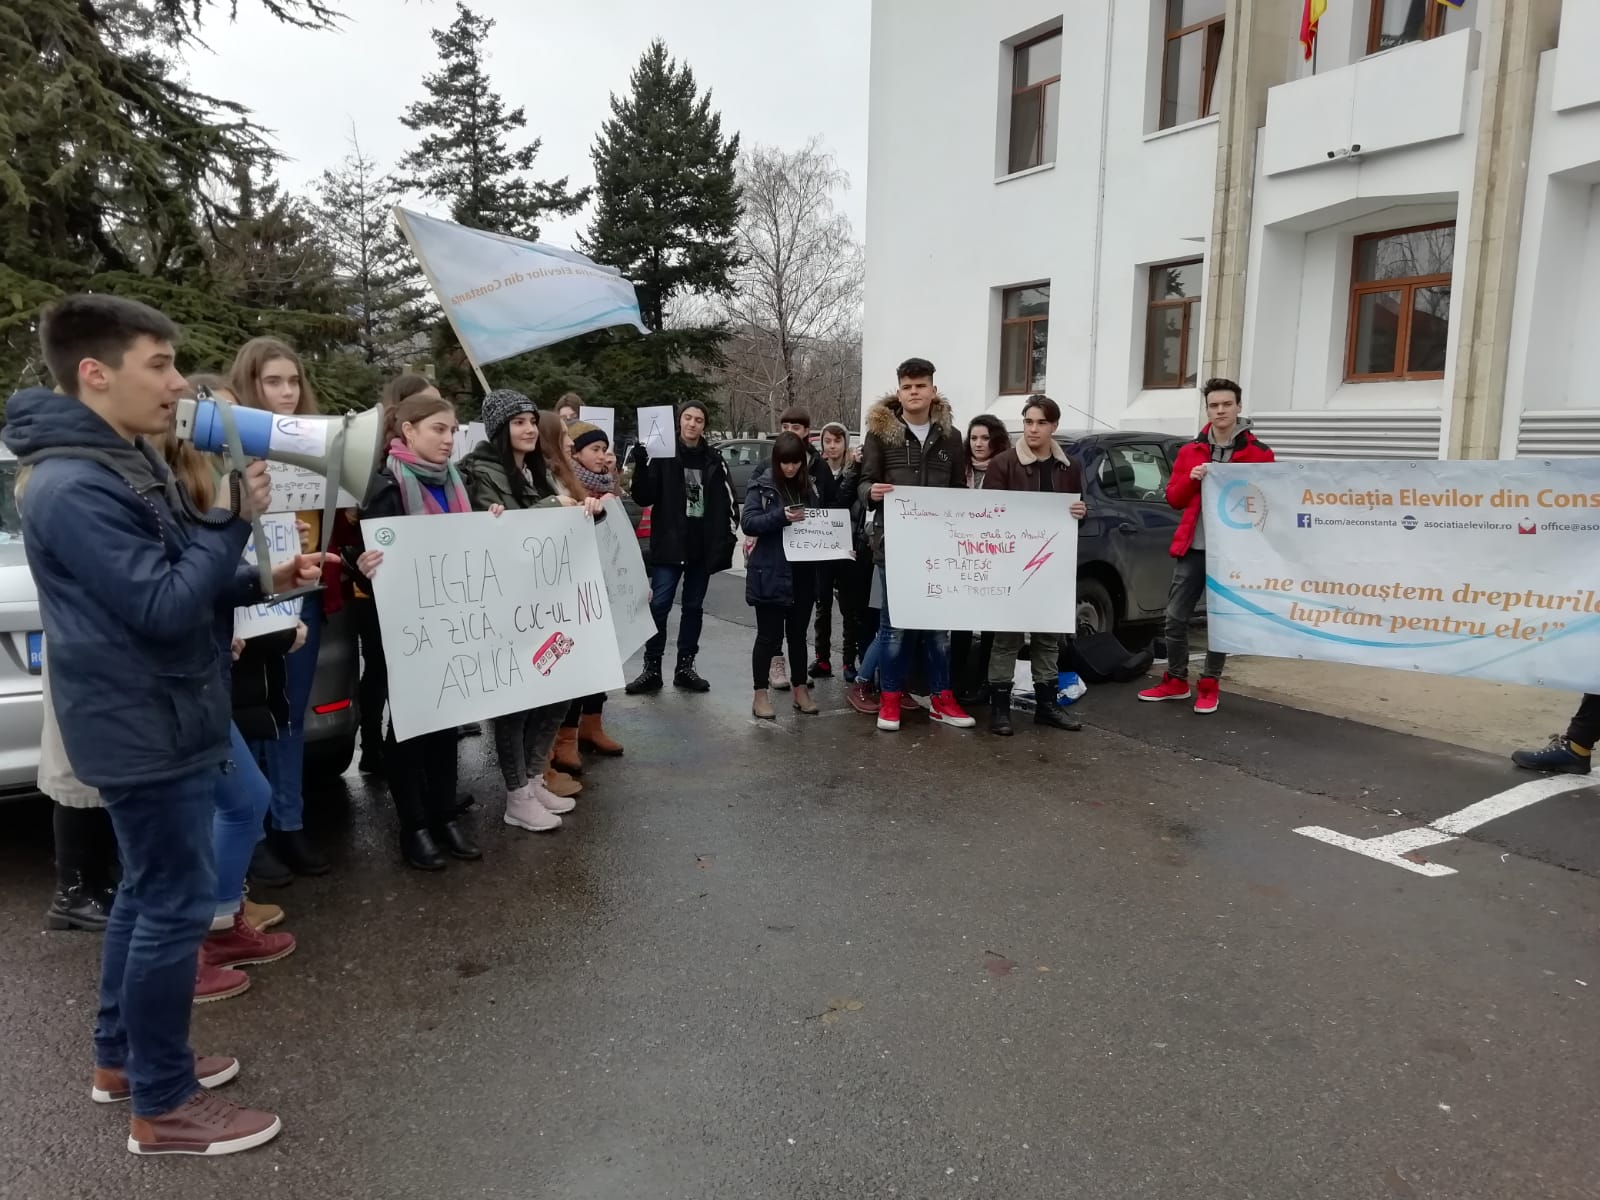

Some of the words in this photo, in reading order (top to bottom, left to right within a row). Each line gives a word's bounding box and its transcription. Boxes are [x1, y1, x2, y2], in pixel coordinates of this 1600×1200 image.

[1302, 489, 1393, 510] Asociația
[1399, 489, 1484, 508] Elevilor
[1490, 489, 1529, 508] din
[1537, 489, 1600, 508] Cons
[804, 509, 829, 518] EGRU
[1314, 517, 1398, 527] fb.com/aeconstanta
[1424, 519, 1512, 531] asociatiaelevilor.ro
[414, 549, 503, 609] LEGEA
[1300, 577, 1445, 603] cunoaștem
[403, 617, 433, 656] SĂ
[577, 581, 603, 625] NU
[1288, 601, 1383, 627] luptăm
[1390, 613, 1486, 637] pentru
[437, 640, 523, 709] APLICĂ
